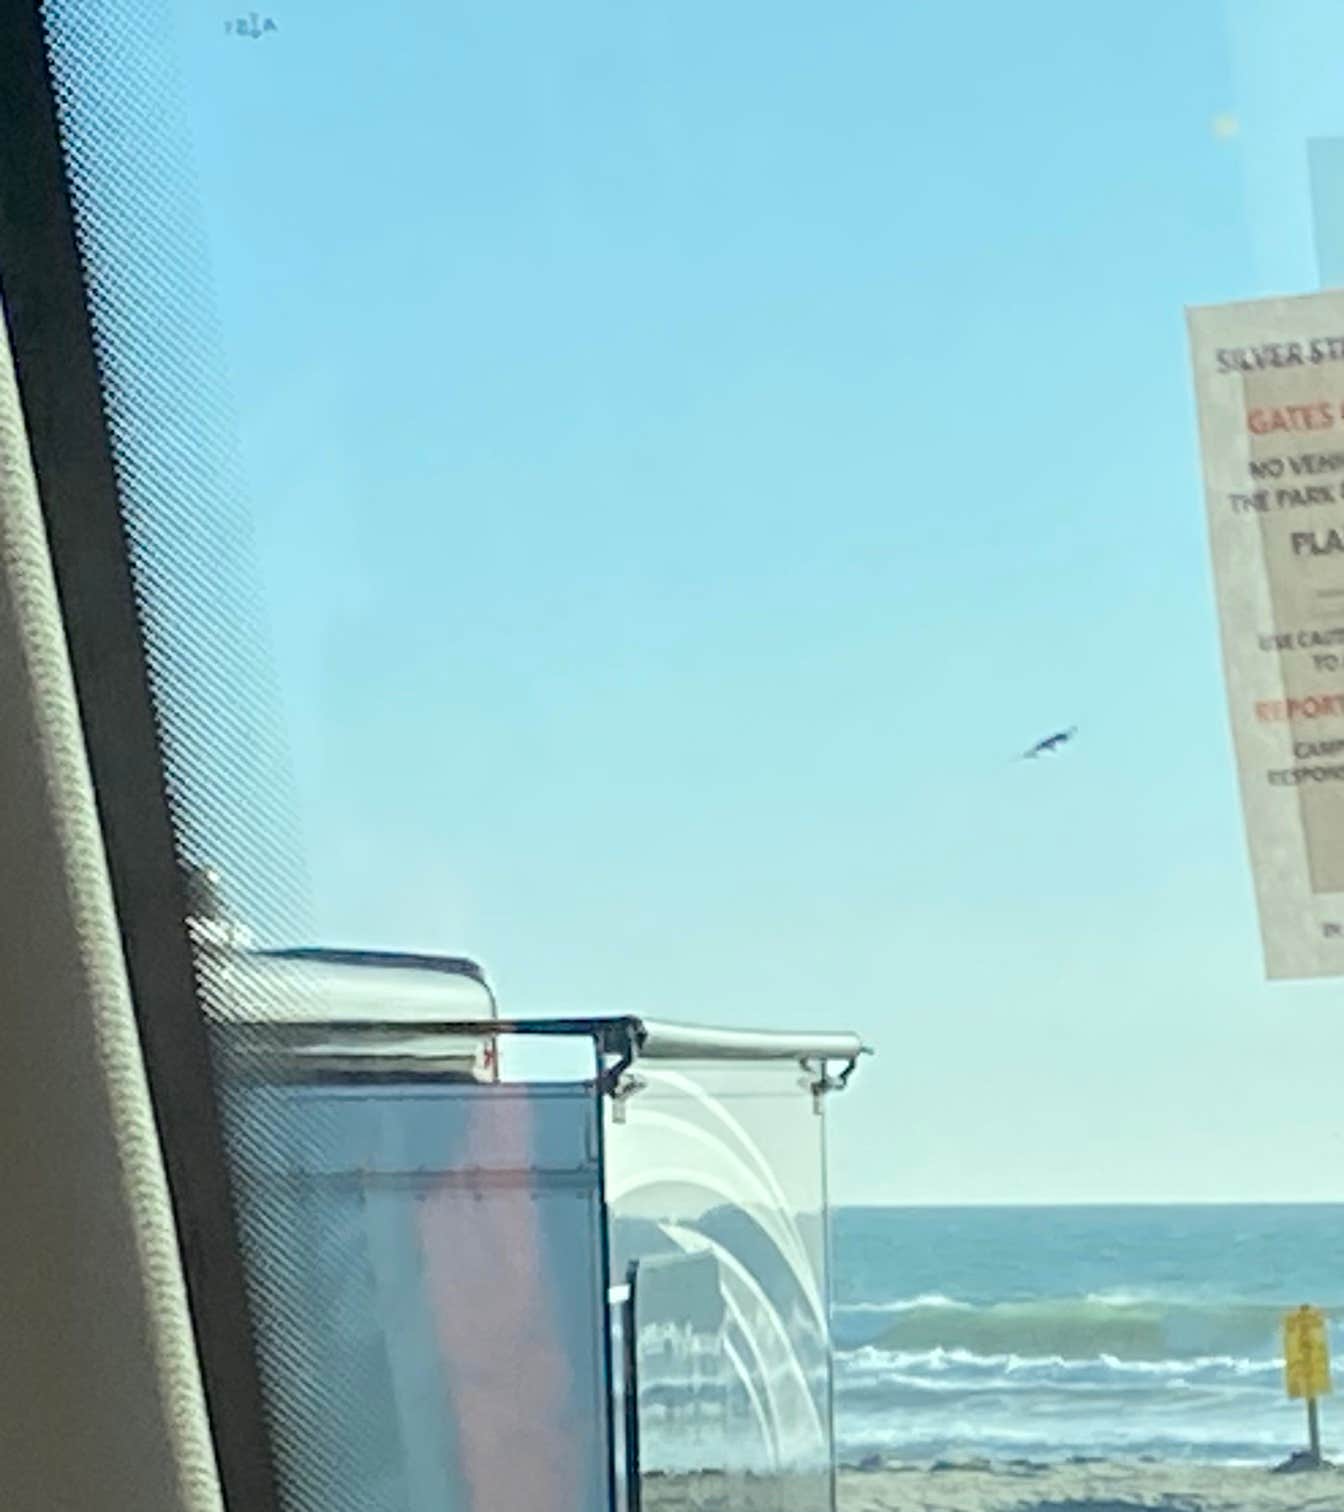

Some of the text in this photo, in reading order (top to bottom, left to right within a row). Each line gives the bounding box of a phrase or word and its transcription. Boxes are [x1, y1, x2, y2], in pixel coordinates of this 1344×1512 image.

[1217, 342, 1303, 374] SILVER
[1248, 402, 1333, 434] GATES
[1248, 458, 1285, 480] NO
[1229, 489, 1270, 515] THE
[1274, 486, 1337, 509] PARK
[1312, 654, 1339, 673] TO
